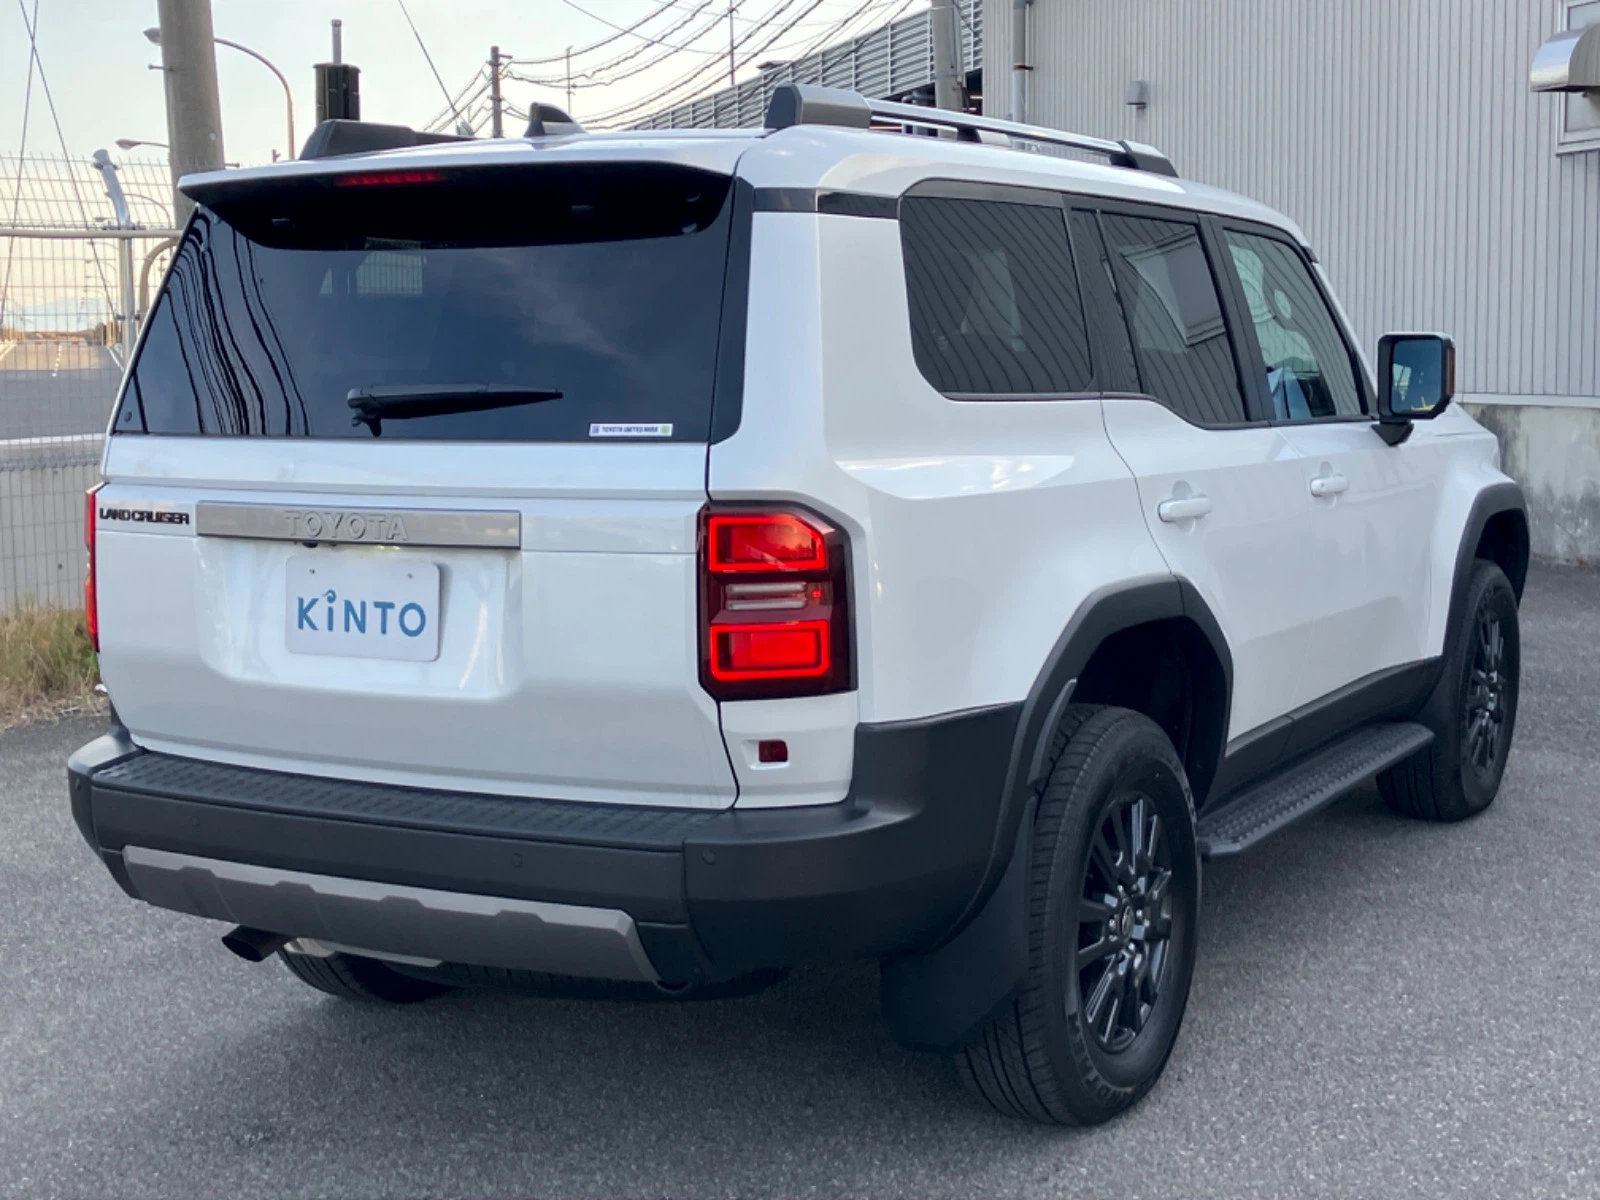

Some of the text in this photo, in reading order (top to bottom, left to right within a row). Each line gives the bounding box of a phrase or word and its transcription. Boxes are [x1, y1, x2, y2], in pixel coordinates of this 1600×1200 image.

[99, 507, 190, 525] LAND CRUISER
[284, 510, 409, 542] TOYOTA
